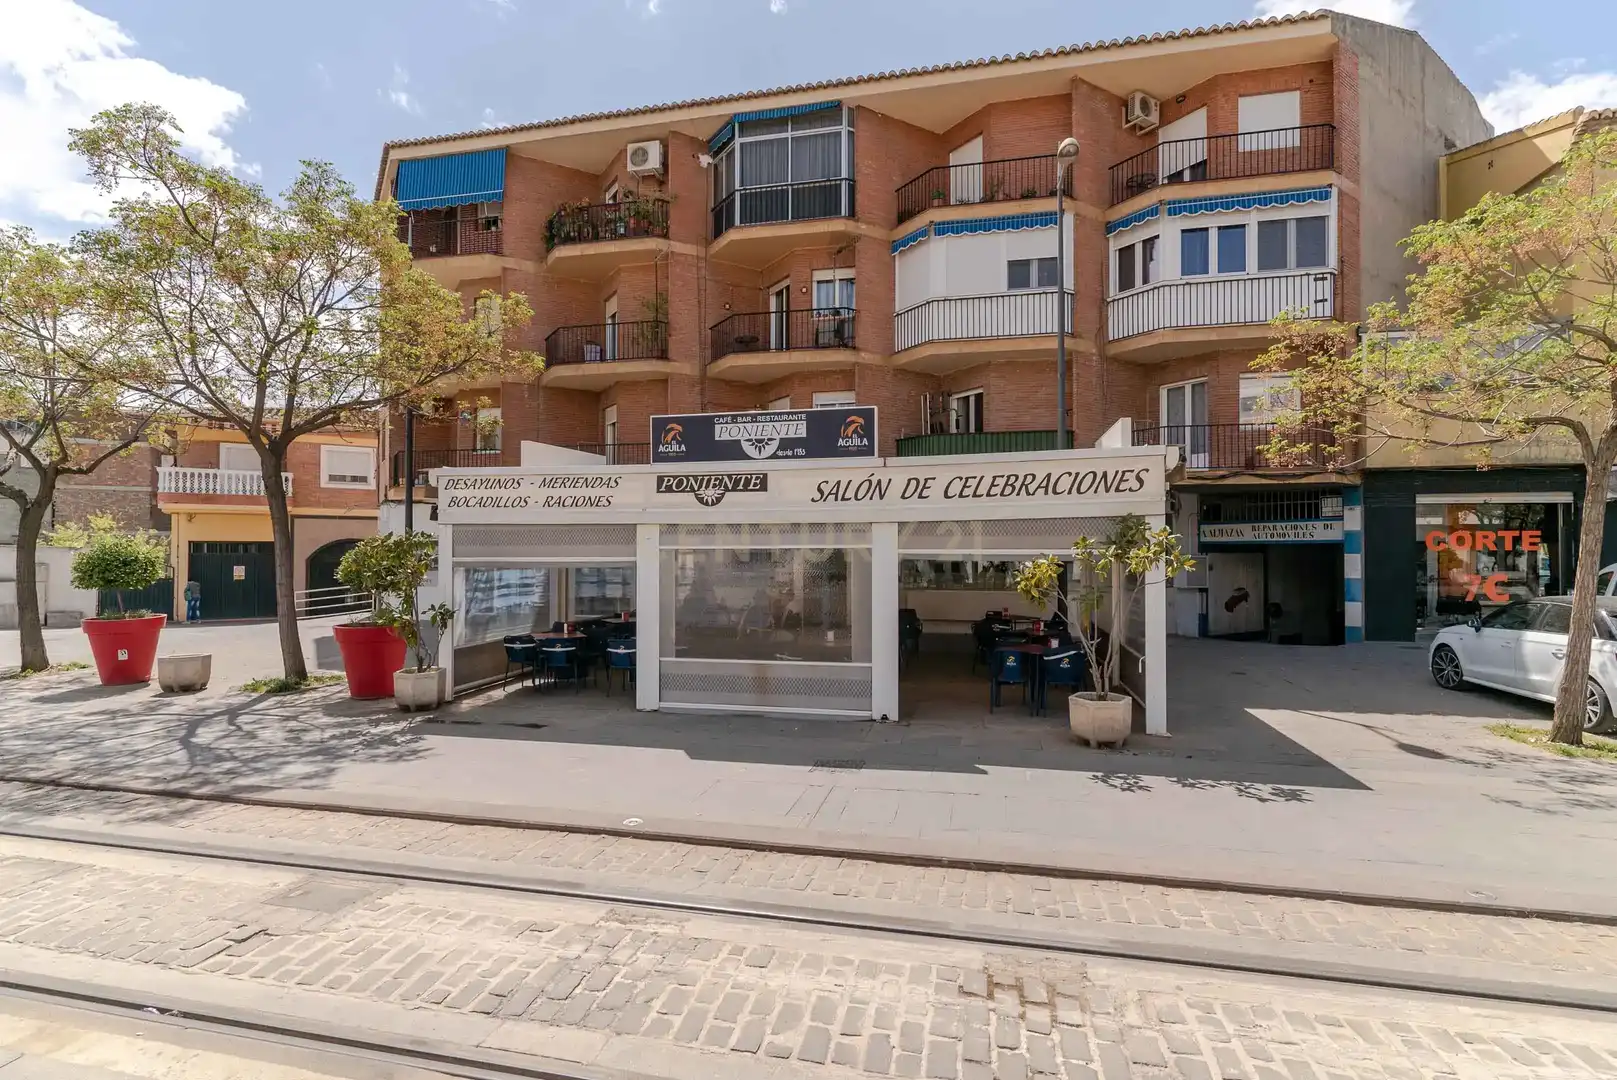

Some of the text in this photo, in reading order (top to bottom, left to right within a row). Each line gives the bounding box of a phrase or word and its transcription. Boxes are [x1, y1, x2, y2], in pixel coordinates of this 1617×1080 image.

[757, 413, 807, 422] RESTAURANTE
[718, 423, 804, 438] PONIENTE
[444, 477, 524, 490] DESAYUNOS
[538, 476, 622, 489] MERIENDAS
[659, 474, 763, 492] PONIENTE
[811, 468, 1150, 502] SALÓN DE CELEBRACIONES
[448, 495, 531, 508] BOCADILLOS
[542, 495, 613, 508] RACIONES
[1251, 523, 1317, 532] REPARACIONES
[1252, 531, 1315, 540] AUTOMOVILES
[1425, 530, 1541, 551] CORTE
